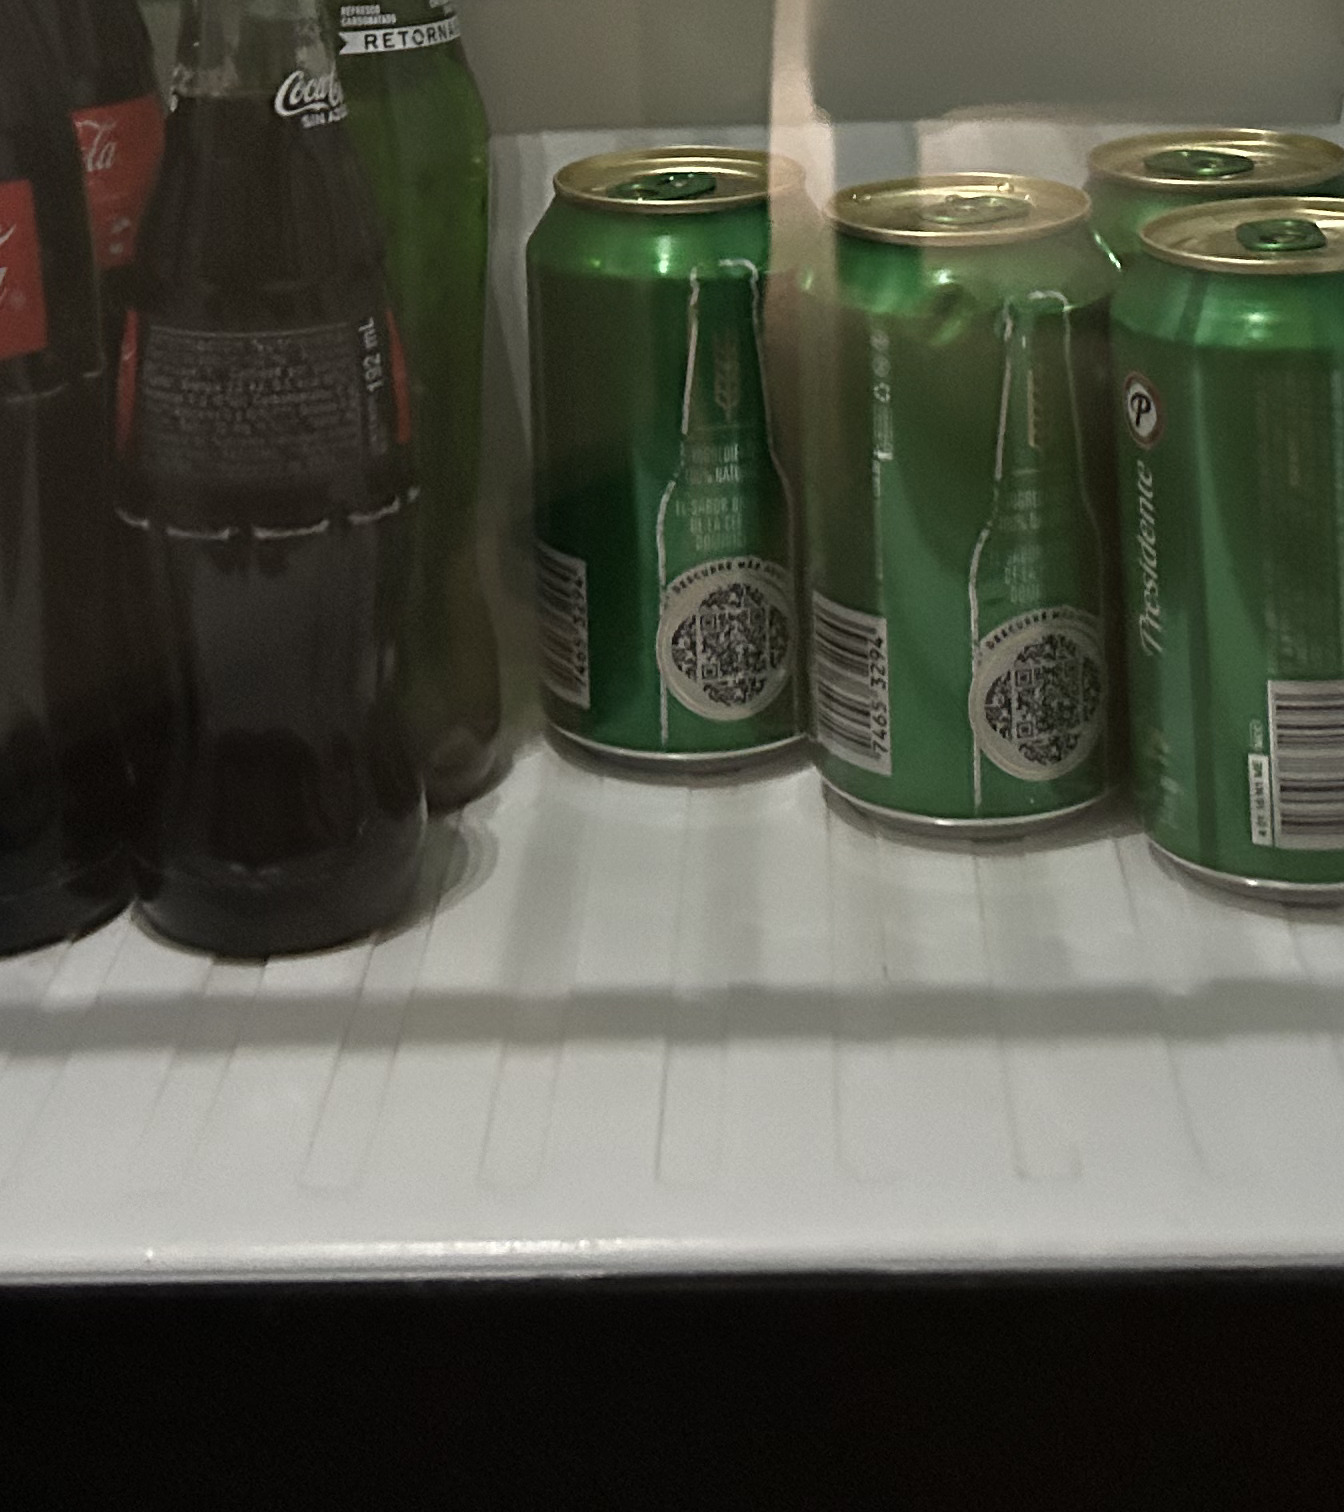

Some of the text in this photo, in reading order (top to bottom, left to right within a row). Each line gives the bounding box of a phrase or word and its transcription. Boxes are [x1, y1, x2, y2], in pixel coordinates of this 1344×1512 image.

[363, 22, 455, 51] RETORNA
[868, 636, 888, 755] 7465 3294
